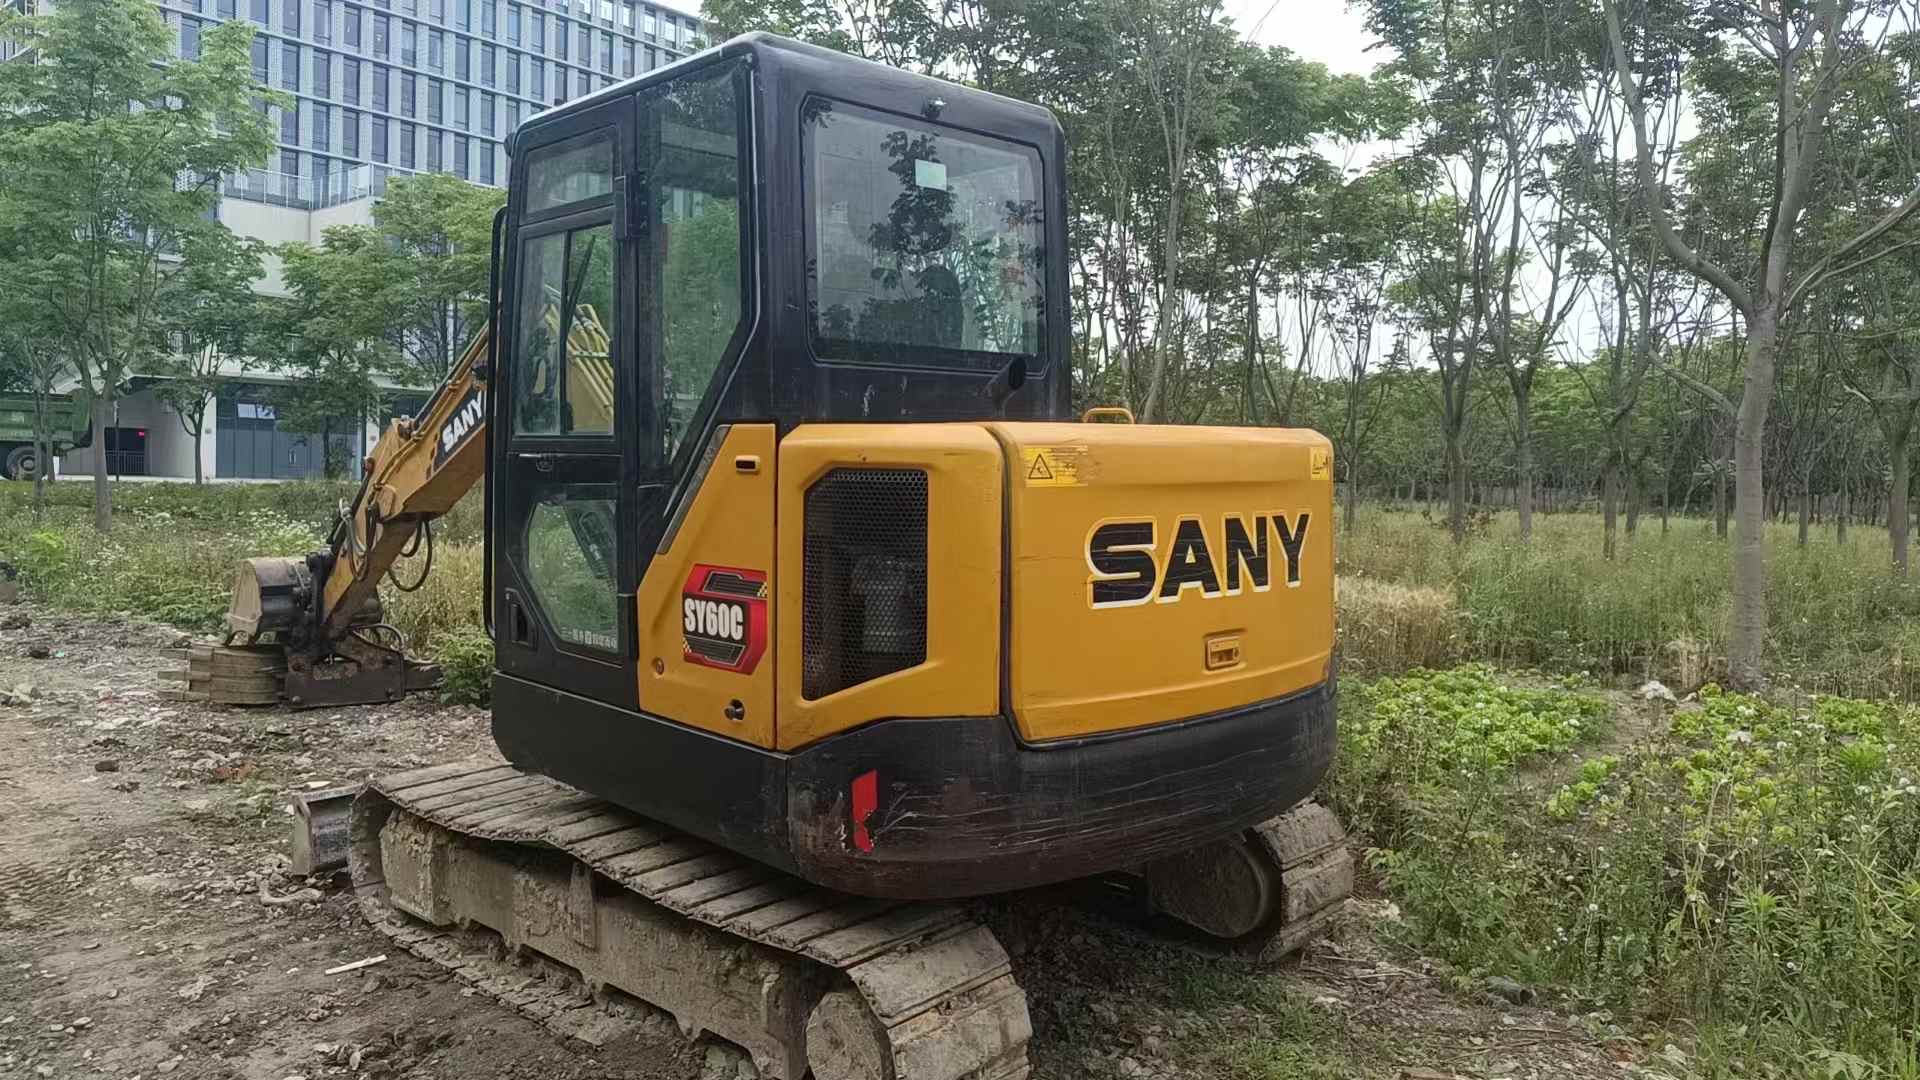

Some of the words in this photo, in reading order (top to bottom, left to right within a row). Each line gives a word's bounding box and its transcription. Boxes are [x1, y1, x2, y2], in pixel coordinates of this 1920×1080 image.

[442, 391, 482, 452] SANY
[1087, 511, 1311, 607] SANY
[684, 598, 743, 640] SY60C
